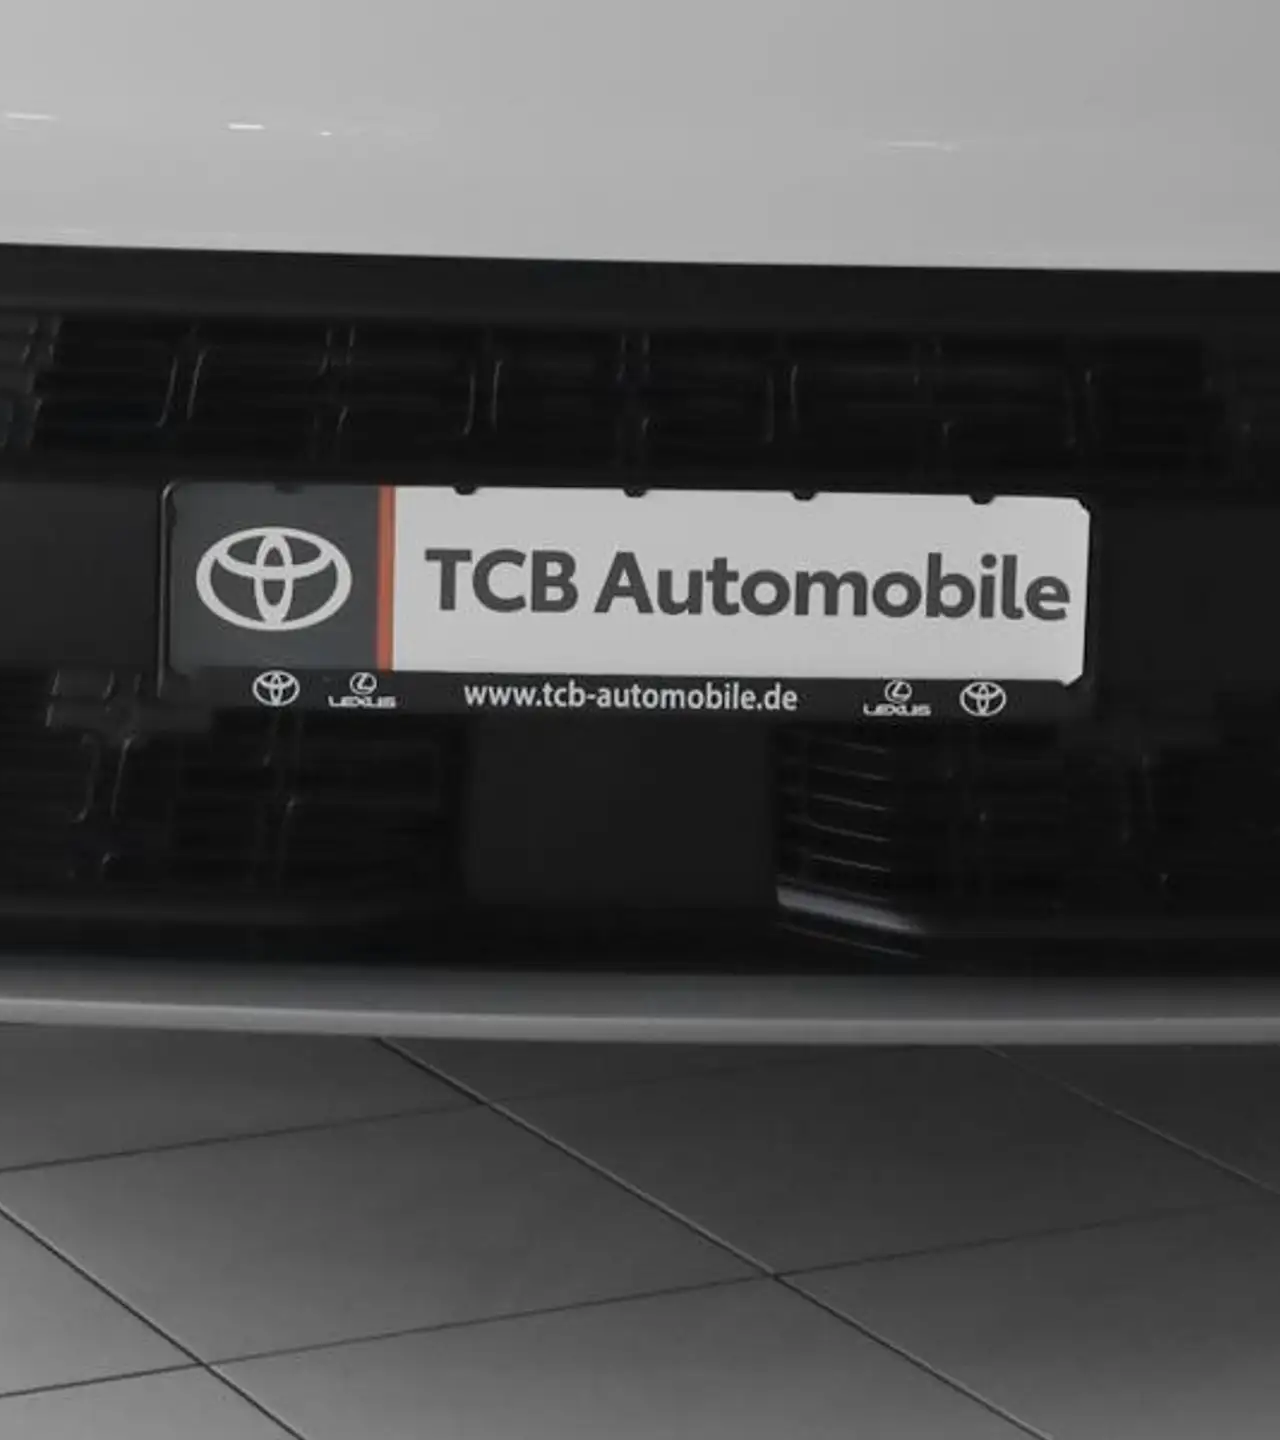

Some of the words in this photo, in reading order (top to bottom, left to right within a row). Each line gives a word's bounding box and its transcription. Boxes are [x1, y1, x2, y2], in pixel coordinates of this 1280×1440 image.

[424, 548, 579, 613] TCB
[593, 551, 1072, 621] Automobile
[327, 695, 397, 709] LEXUS
[463, 679, 798, 711] www.tcb-automobile.de
[862, 703, 932, 717] LEXUS
